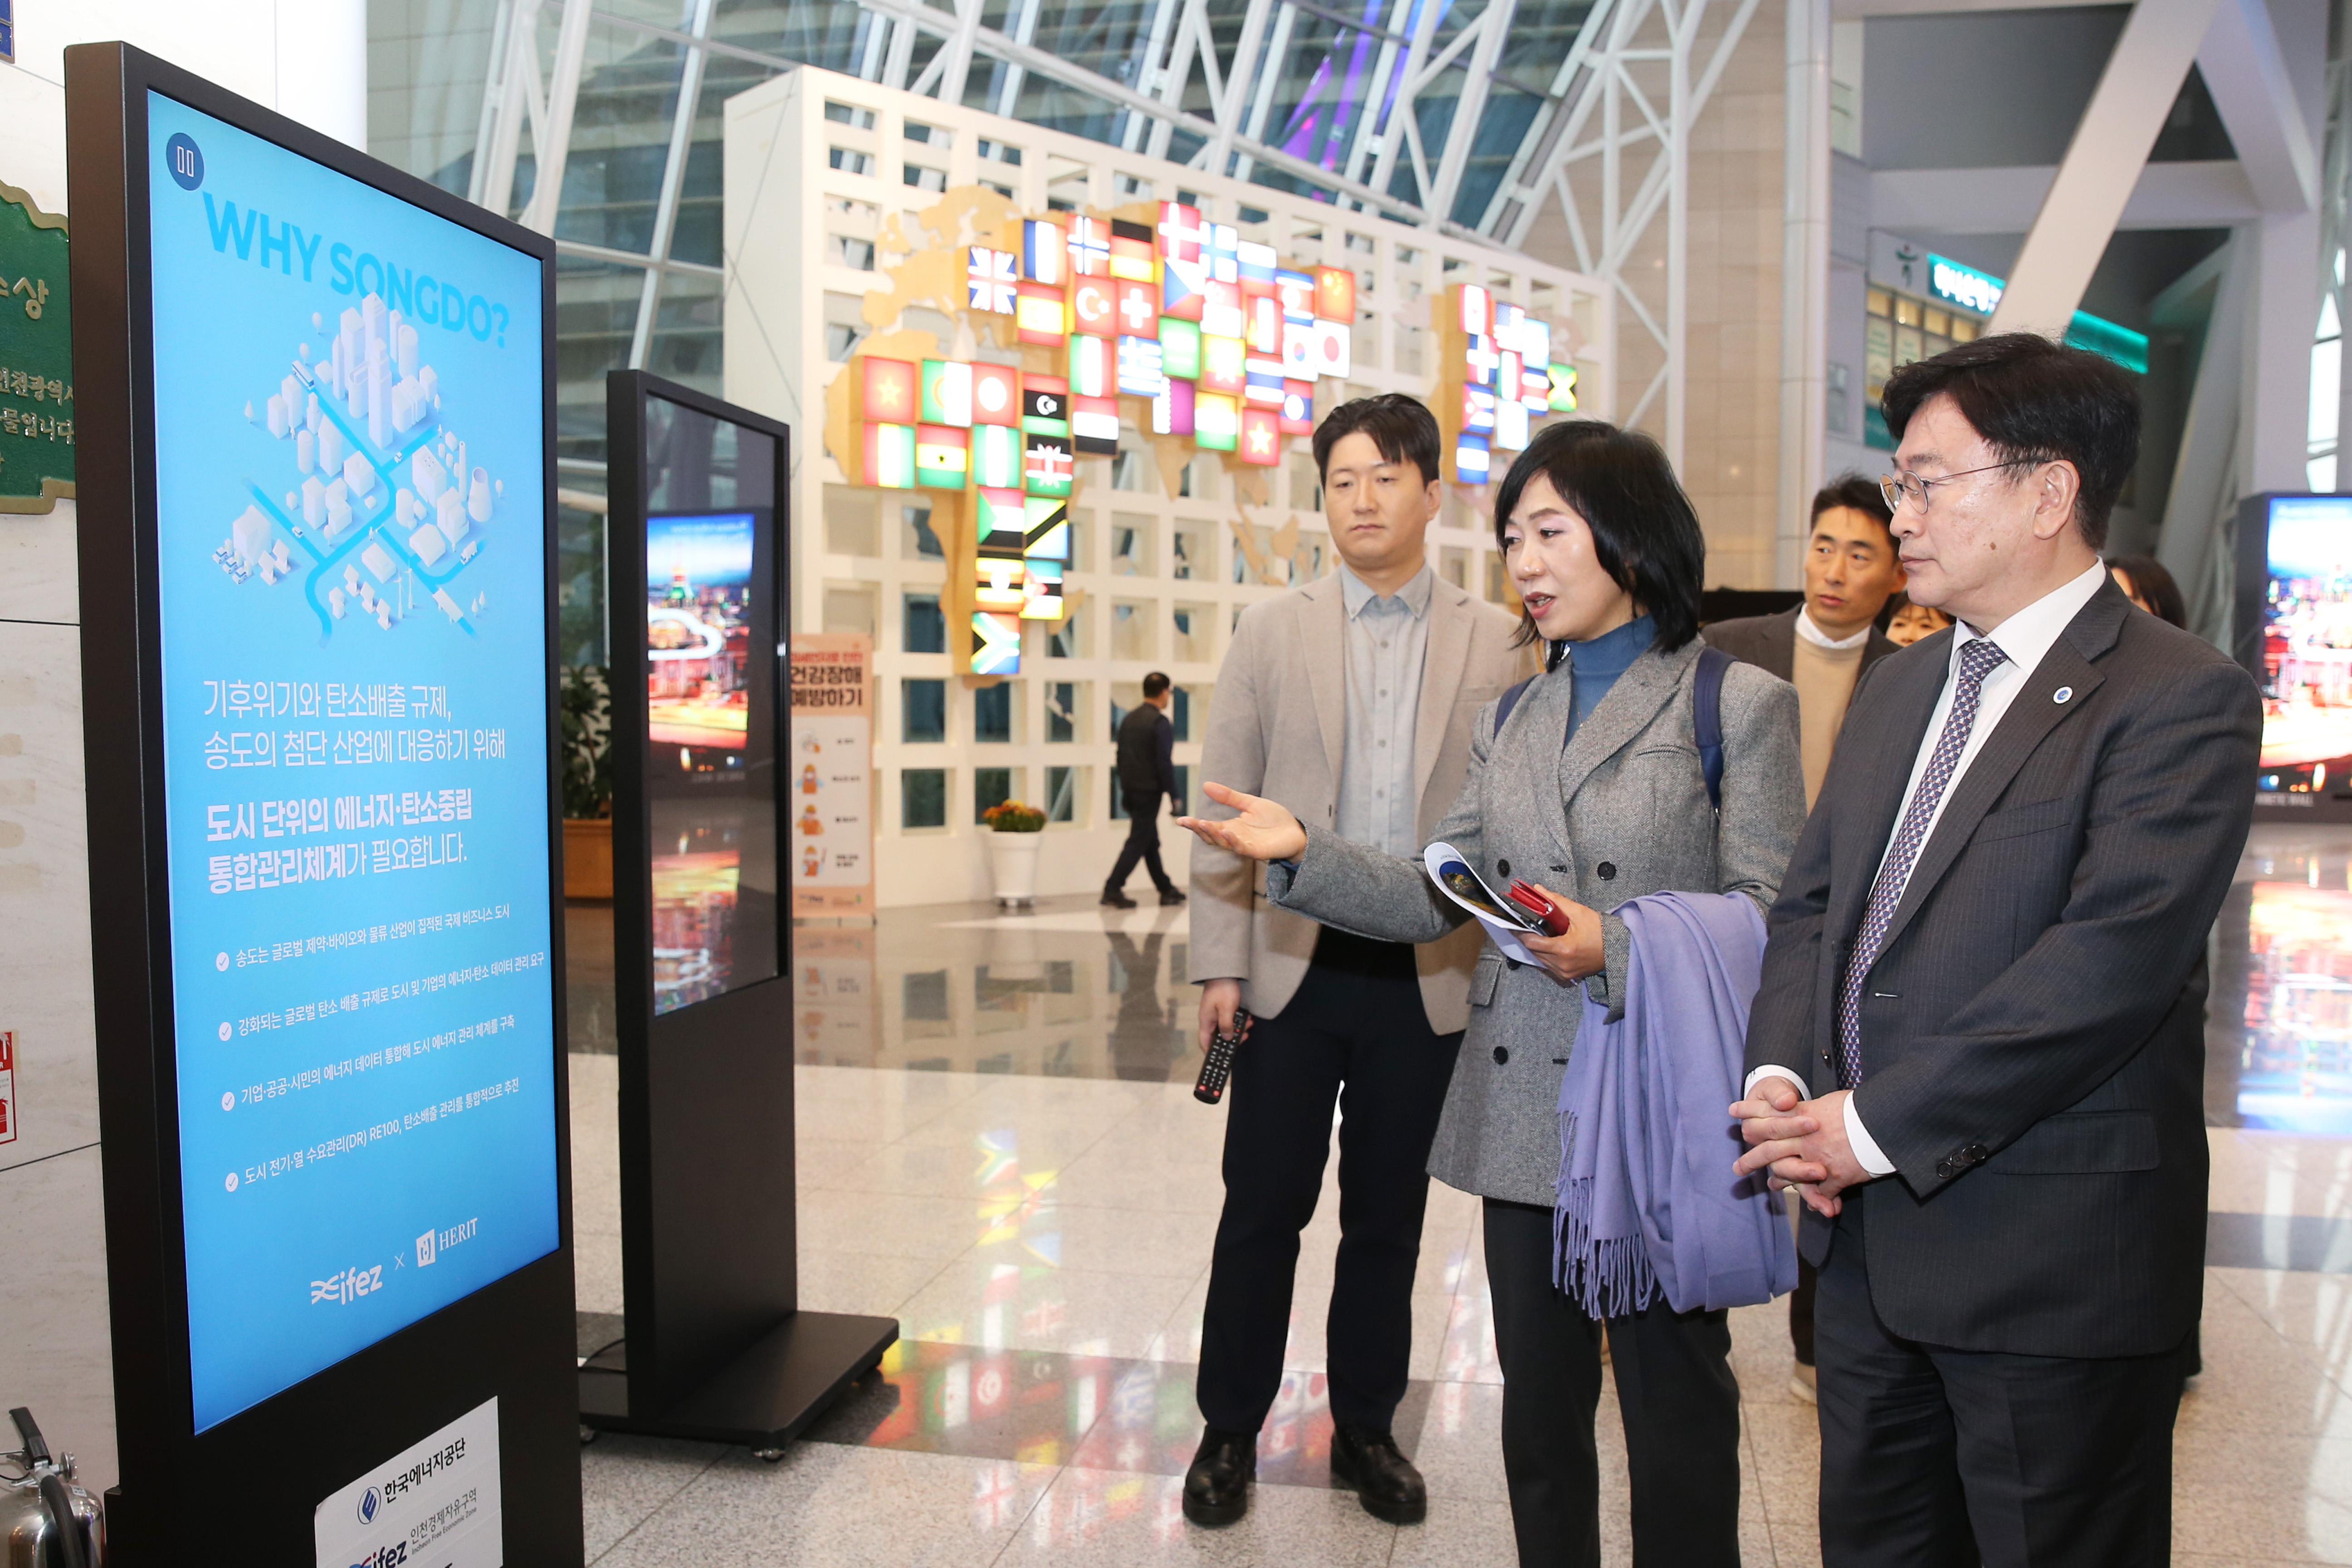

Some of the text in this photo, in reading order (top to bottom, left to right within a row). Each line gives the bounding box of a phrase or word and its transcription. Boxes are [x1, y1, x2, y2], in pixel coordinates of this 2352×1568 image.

[202, 191, 509, 348] WHY SONGDO?
[203, 679, 451, 721] 기후위기와 탄소배출 규제,
[791, 666, 862, 684] 건강장해
[205, 729, 505, 769] 송도의 첨단 산업에 대응하기 위해
[207, 788, 472, 841] 도시 단위의 에너지·탄소중립
[208, 832, 467, 894] 통합관리체계가 필요합니다.
[236, 903, 510, 967] 송도는 글로벌 제약·바이오와 물류 산업이 집적된 국제 비즈니스 도시
[239, 952, 544, 1036] 강화되는 글로벌 탄소 배출 규제로 도시 및 기업의 에너지·탄소 데이터 관리 요구
[241, 1014, 514, 1103] 기업·공공·시민의 에너지 데이터 통합해 도시 에너지 관리 체계를 구축
[245, 1078, 519, 1184] 도시 전기·열 수요관리(DR) RE100, 탄소배출 관리를 통합적으로 추진
[340, 1265, 382, 1305] ifez
[439, 1218, 478, 1250] HERIT
[385, 1438, 466, 1504] 한국에너지공단
[411, 1488, 476, 1544] 인천경제자유구역
[412, 1507, 476, 1555] Incheon Free Economic Zone
